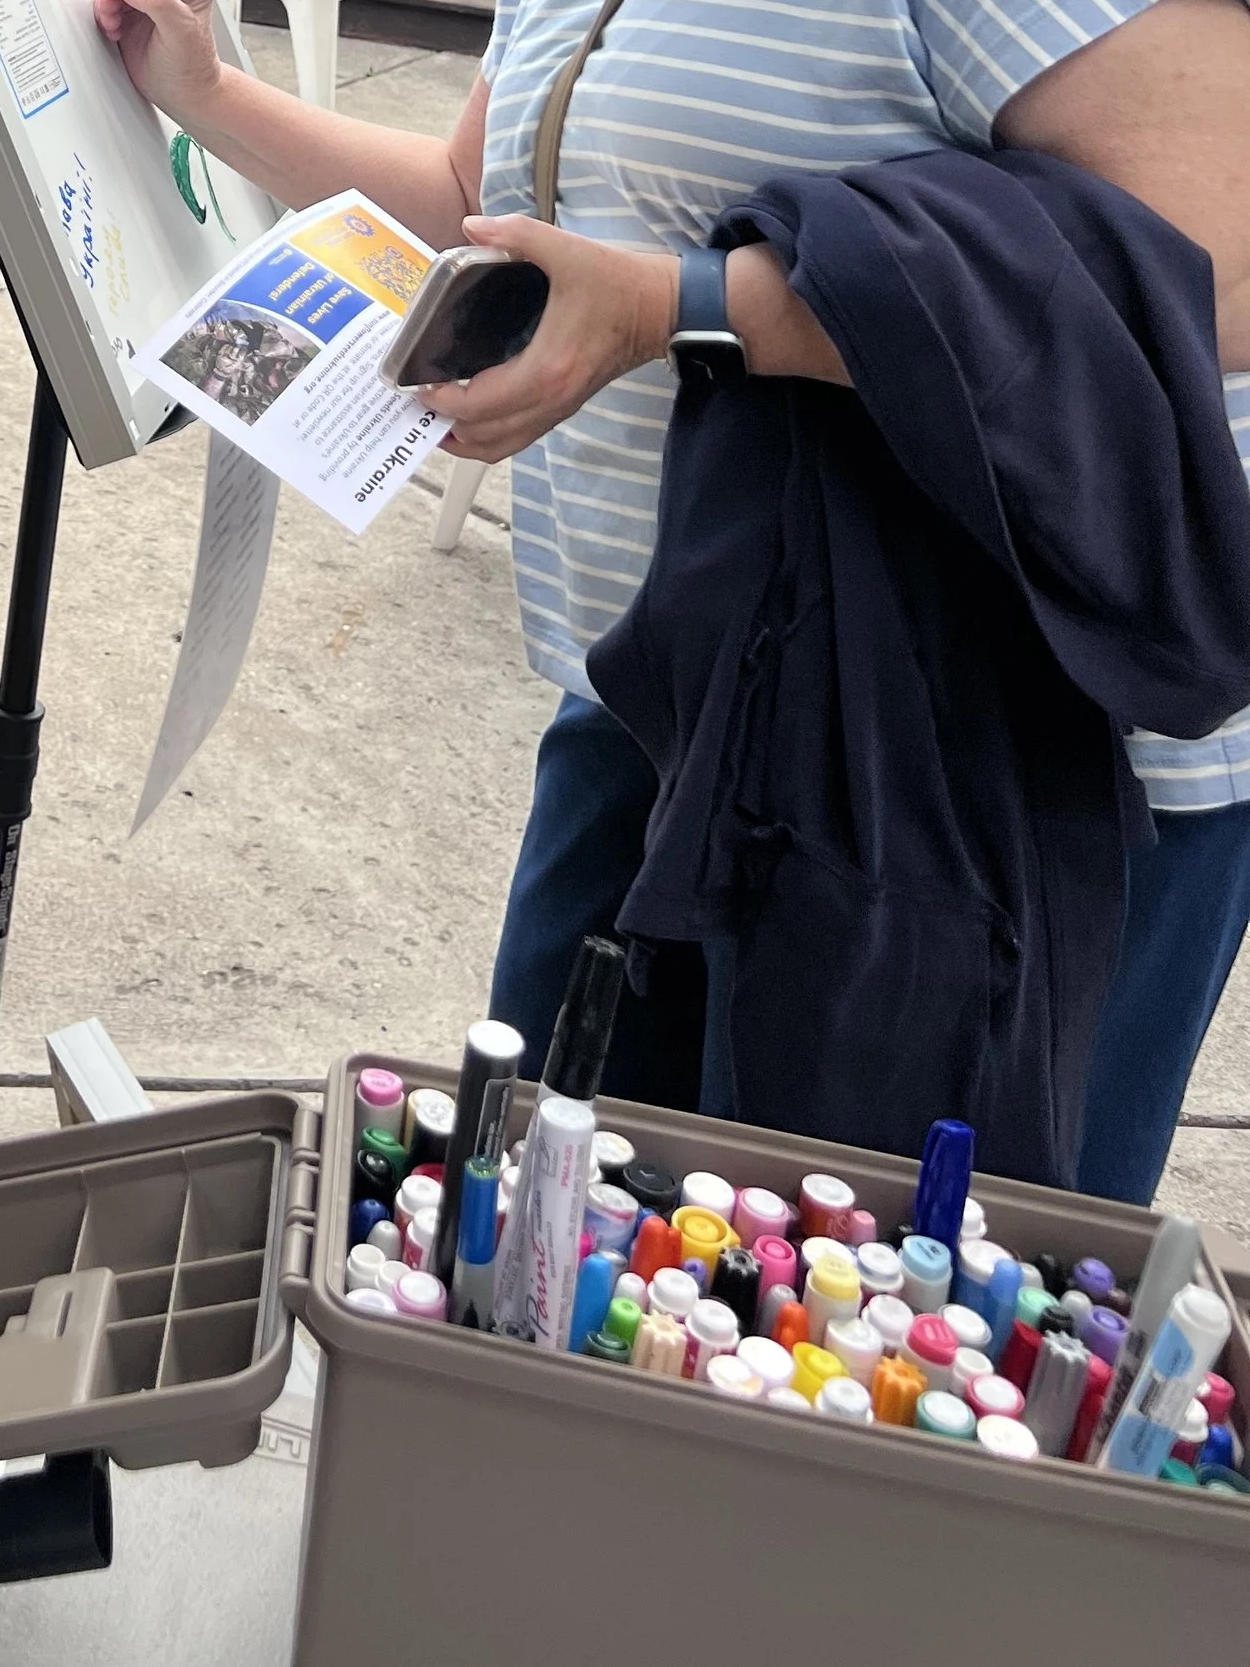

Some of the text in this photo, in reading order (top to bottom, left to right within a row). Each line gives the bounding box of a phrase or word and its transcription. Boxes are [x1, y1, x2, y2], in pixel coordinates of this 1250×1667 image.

[269, 260, 316, 300] Defenders!
[285, 279, 327, 314] Ukrainian
[307, 286, 351, 323] Save Lives
[358, 361, 374, 376] Sign
[349, 374, 359, 385] up
[341, 384, 353, 395] for
[329, 394, 342, 408] our
[321, 402, 352, 437] assistance
[355, 403, 370, 421] gear
[388, 409, 402, 424] you
[348, 420, 358, 428] to
[378, 423, 391, 436] can
[314, 436, 324, 445] to
[317, 392, 401, 482] Seeds Ukraine by providing
[364, 436, 382, 452] help
[354, 408, 438, 502] ce in Ukraine
[341, 451, 368, 478] Ukraine
[526, 1222, 550, 1337] Paint
